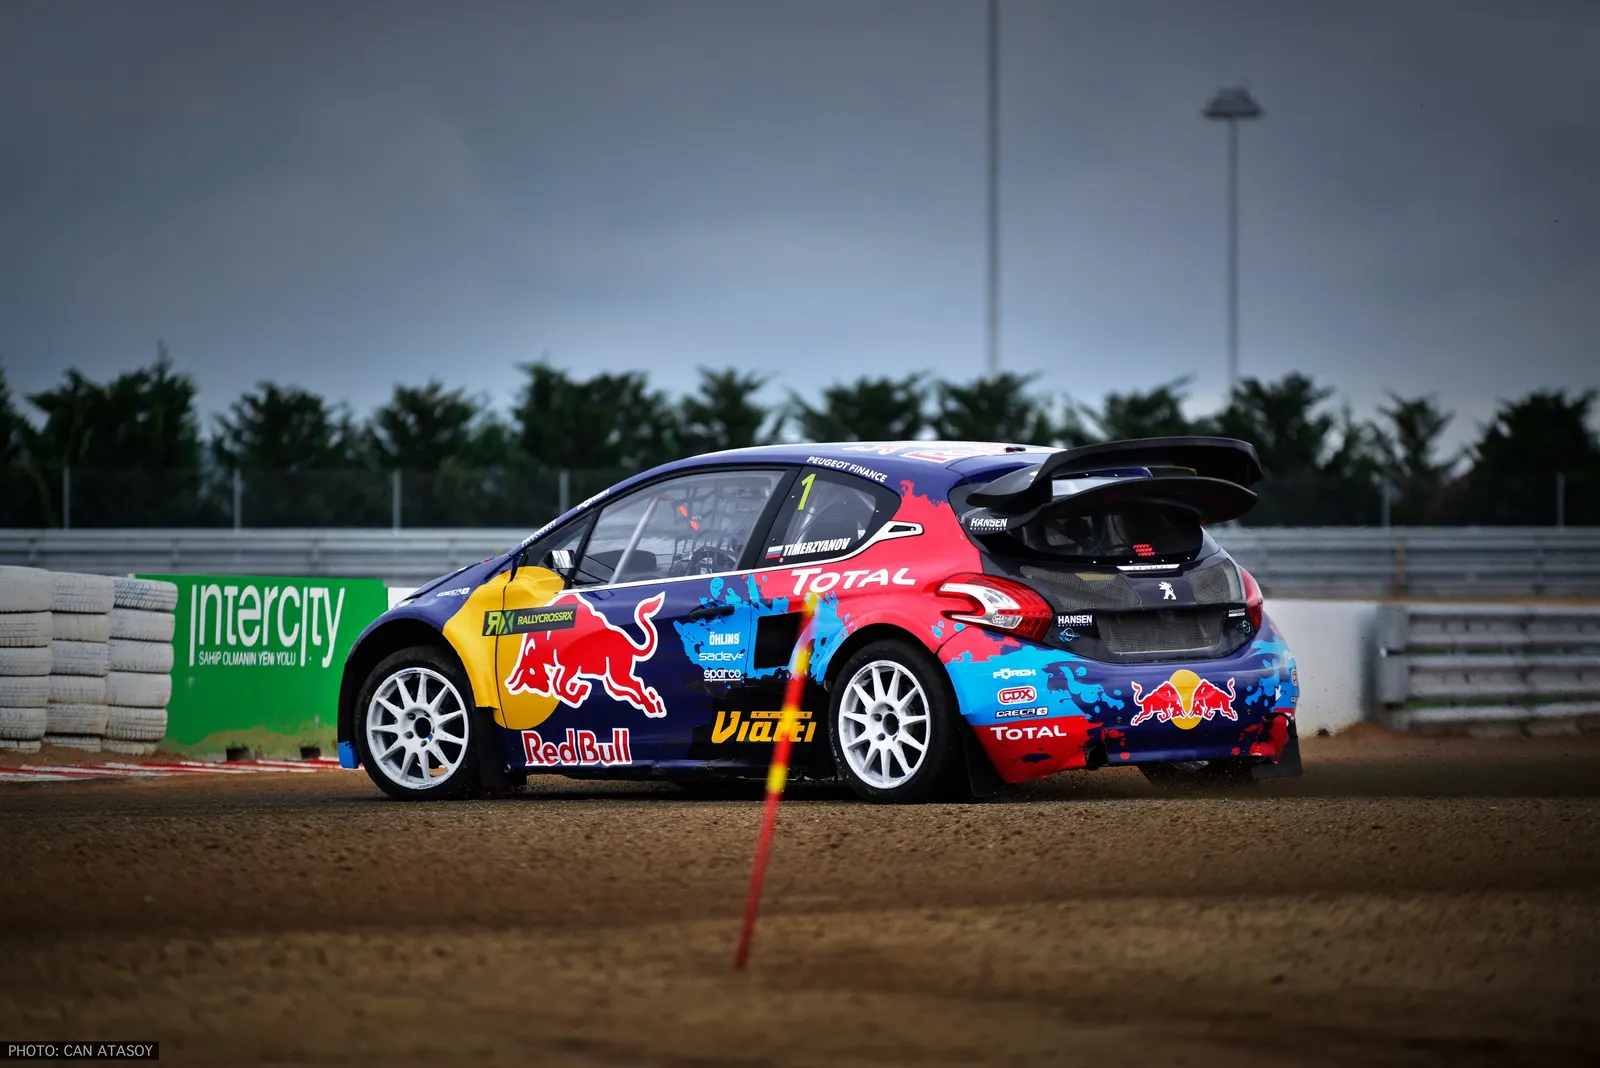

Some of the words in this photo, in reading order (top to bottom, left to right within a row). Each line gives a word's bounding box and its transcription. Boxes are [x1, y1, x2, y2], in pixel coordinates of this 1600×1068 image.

[806, 456, 851, 469] PEUGEOT
[849, 463, 888, 483] FINANCE
[797, 473, 817, 511] 1
[970, 517, 1009, 528] HANSEN
[782, 537, 852, 557] TIMERZYANOV
[791, 567, 917, 596] TOTAL
[517, 611, 574, 626] RALLYCROSSRX
[1057, 614, 1093, 624] HANSEN
[276, 651, 297, 666] YOLU
[703, 669, 741, 682] sparco
[1001, 689, 1033, 702] CDX
[990, 724, 1067, 741] TOTAL
[521, 728, 579, 766] Red
[577, 728, 633, 766] Bull
